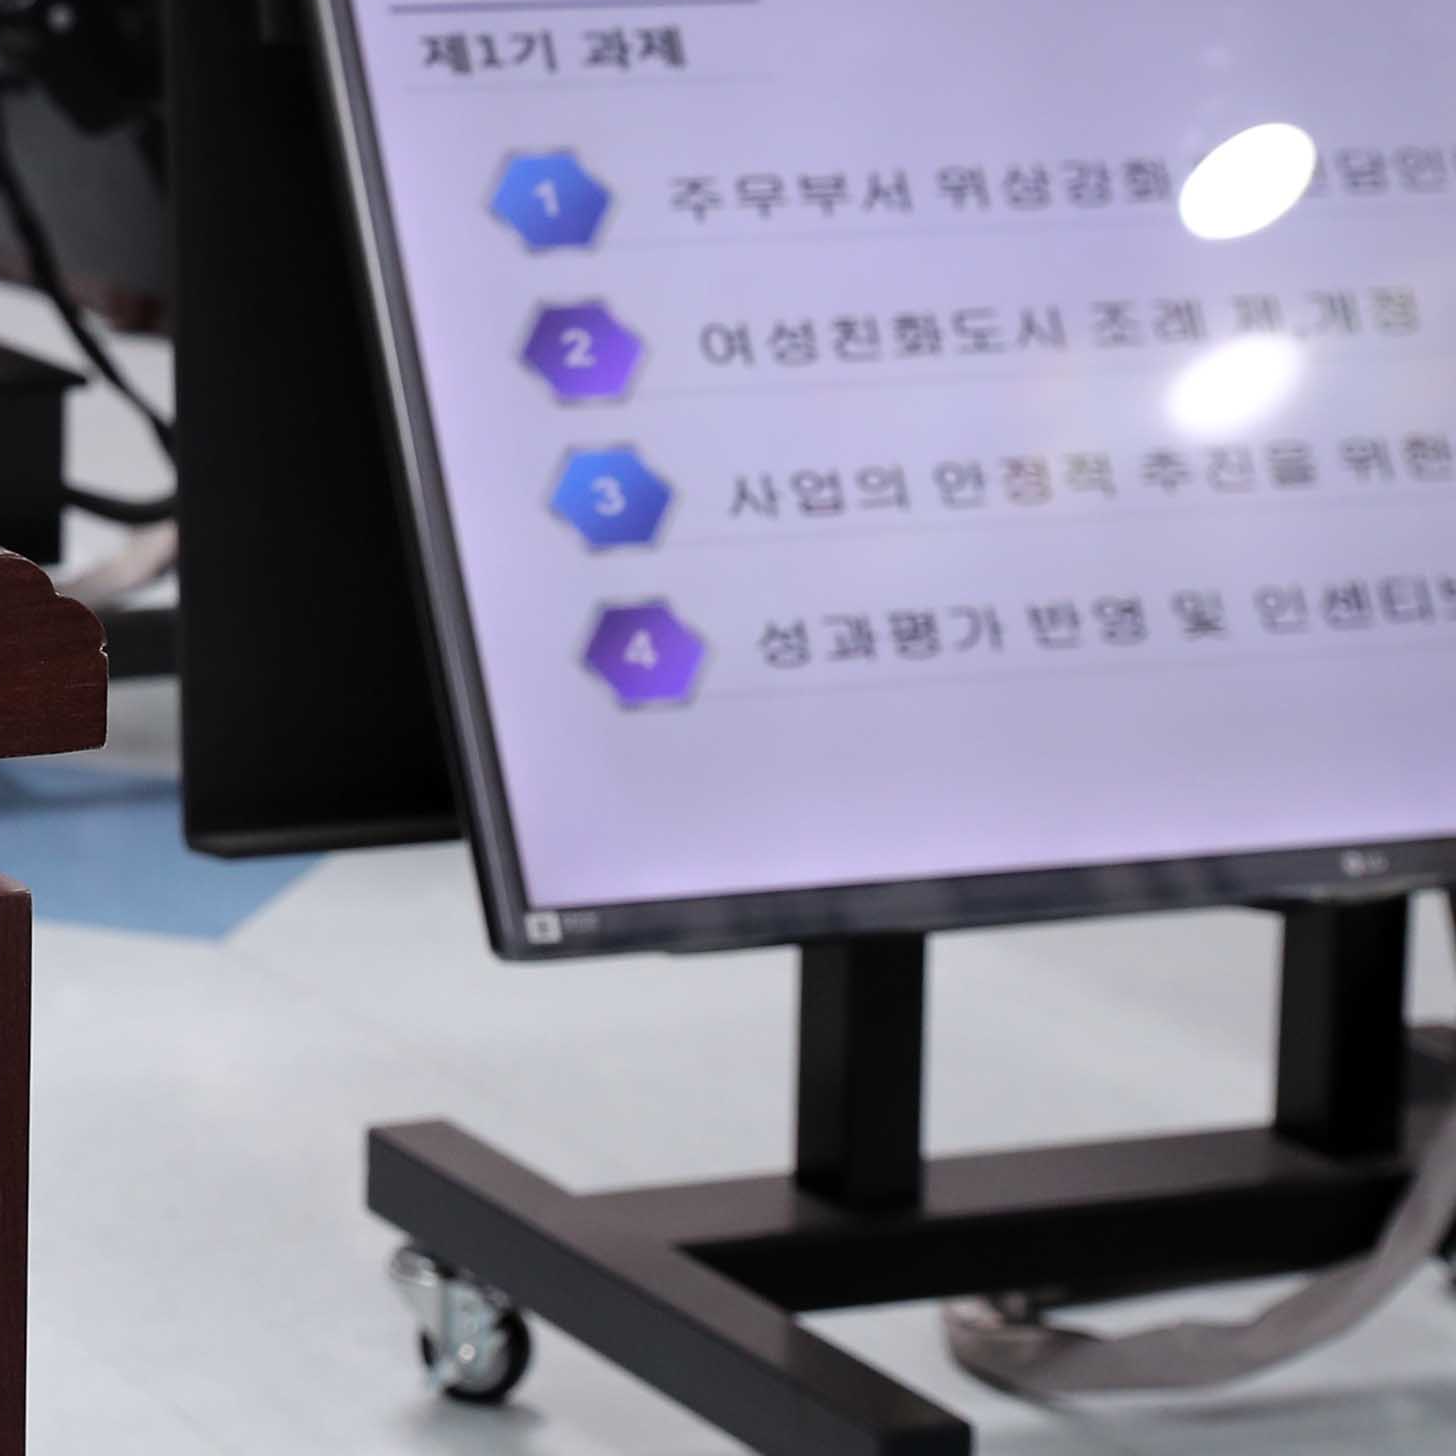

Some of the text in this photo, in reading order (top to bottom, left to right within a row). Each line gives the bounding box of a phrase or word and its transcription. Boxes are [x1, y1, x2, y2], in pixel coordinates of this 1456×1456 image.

[420, 25, 686, 75] 제1기 과제
[533, 177, 561, 220] 1
[669, 169, 915, 223] 주무부서
[936, 157, 1173, 211] 위상강화
[560, 326, 598, 370] 2
[699, 305, 1071, 368] 여성친화도시
[1090, 298, 1207, 346] 조례
[590, 475, 628, 517] 3
[729, 462, 911, 519] 사업의
[931, 450, 1117, 509] 안정적
[1140, 438, 1318, 493] 추진을
[623, 628, 660, 671] 4
[760, 601, 1005, 671] 성과평가
[1026, 594, 1149, 650] 반영
[1171, 589, 1227, 641] 및
